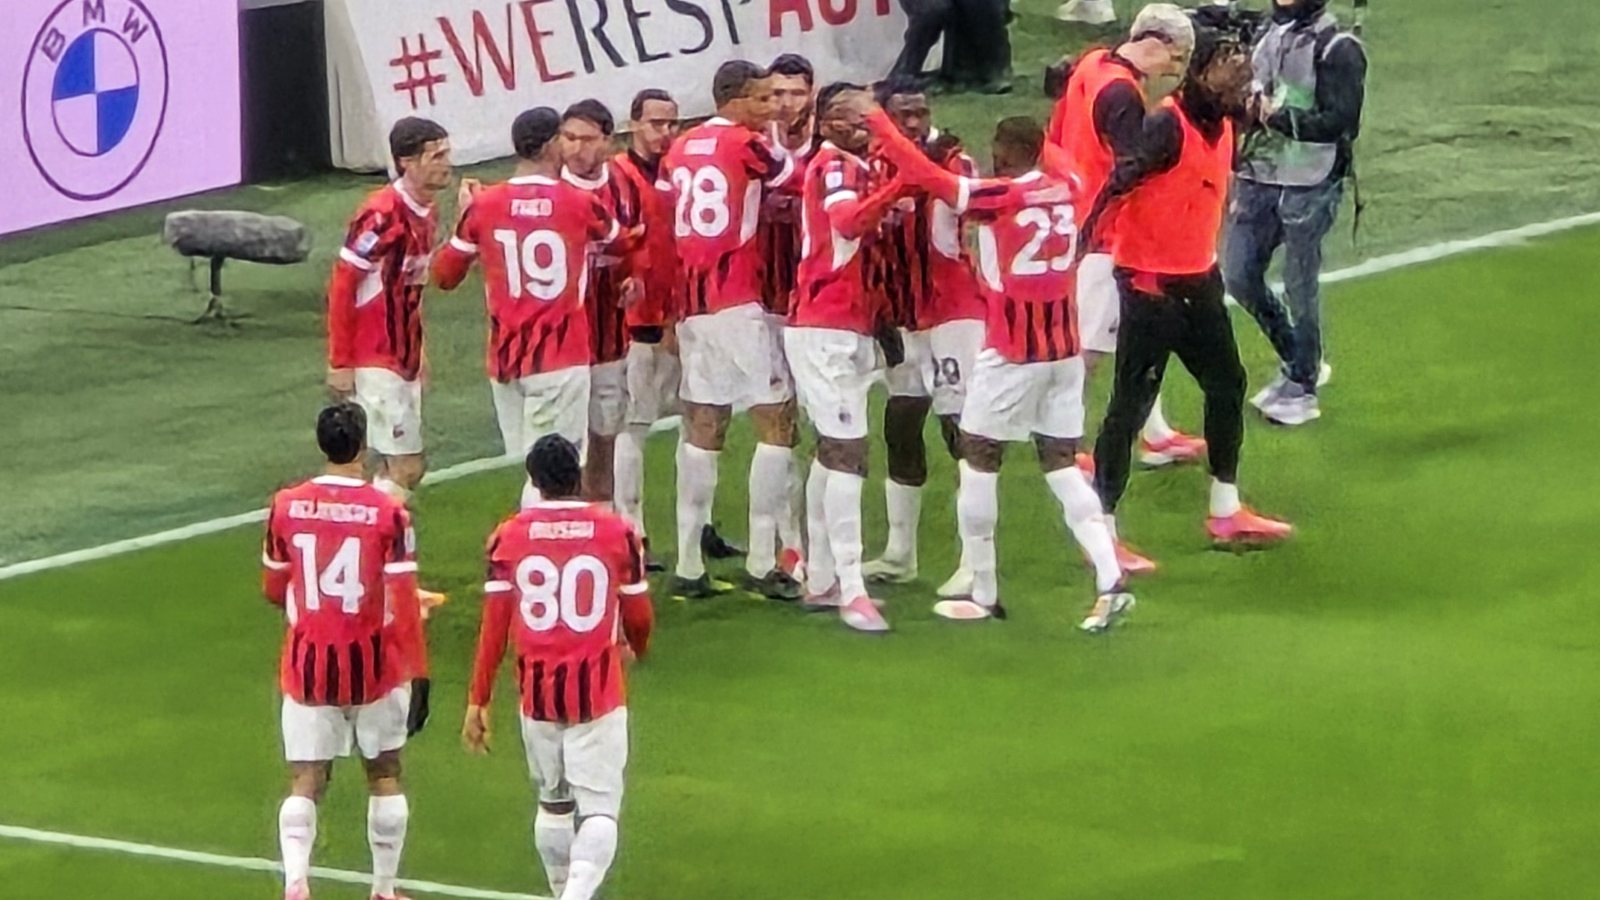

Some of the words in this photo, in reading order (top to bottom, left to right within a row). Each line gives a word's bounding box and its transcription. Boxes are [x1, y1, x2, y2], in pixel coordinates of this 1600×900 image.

[41, 0, 149, 63] BMW
[389, 0, 891, 110] #WERESPA
[493, 228, 568, 300] 19
[1011, 205, 1078, 275] 23
[292, 533, 365, 614] 14
[515, 554, 610, 633] 80
